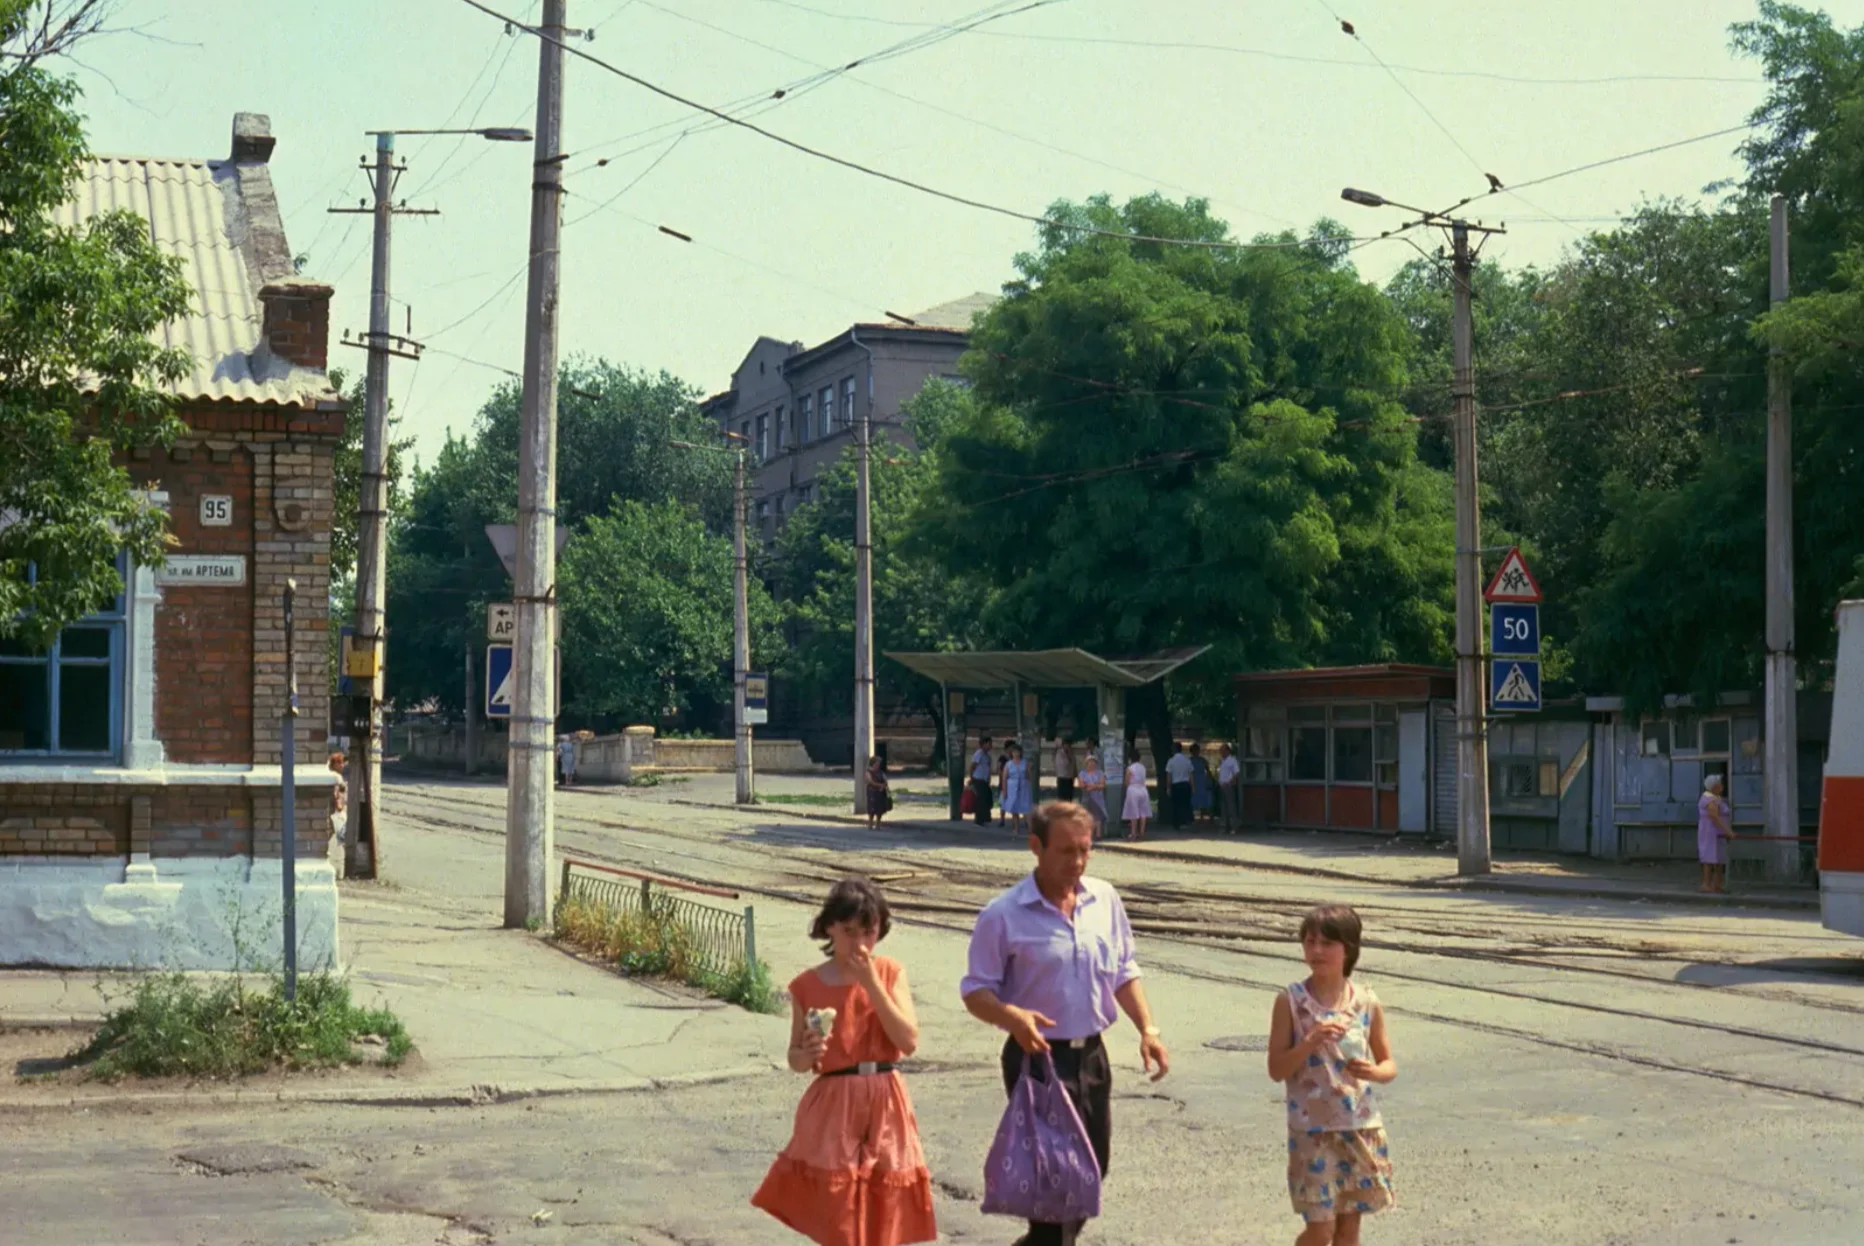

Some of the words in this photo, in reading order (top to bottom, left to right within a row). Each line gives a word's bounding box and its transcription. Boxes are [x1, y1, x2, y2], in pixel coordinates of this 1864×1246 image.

[205, 500, 226, 519] 95
[195, 564, 235, 577] АРТЕМА
[1503, 616, 1529, 640] 50
